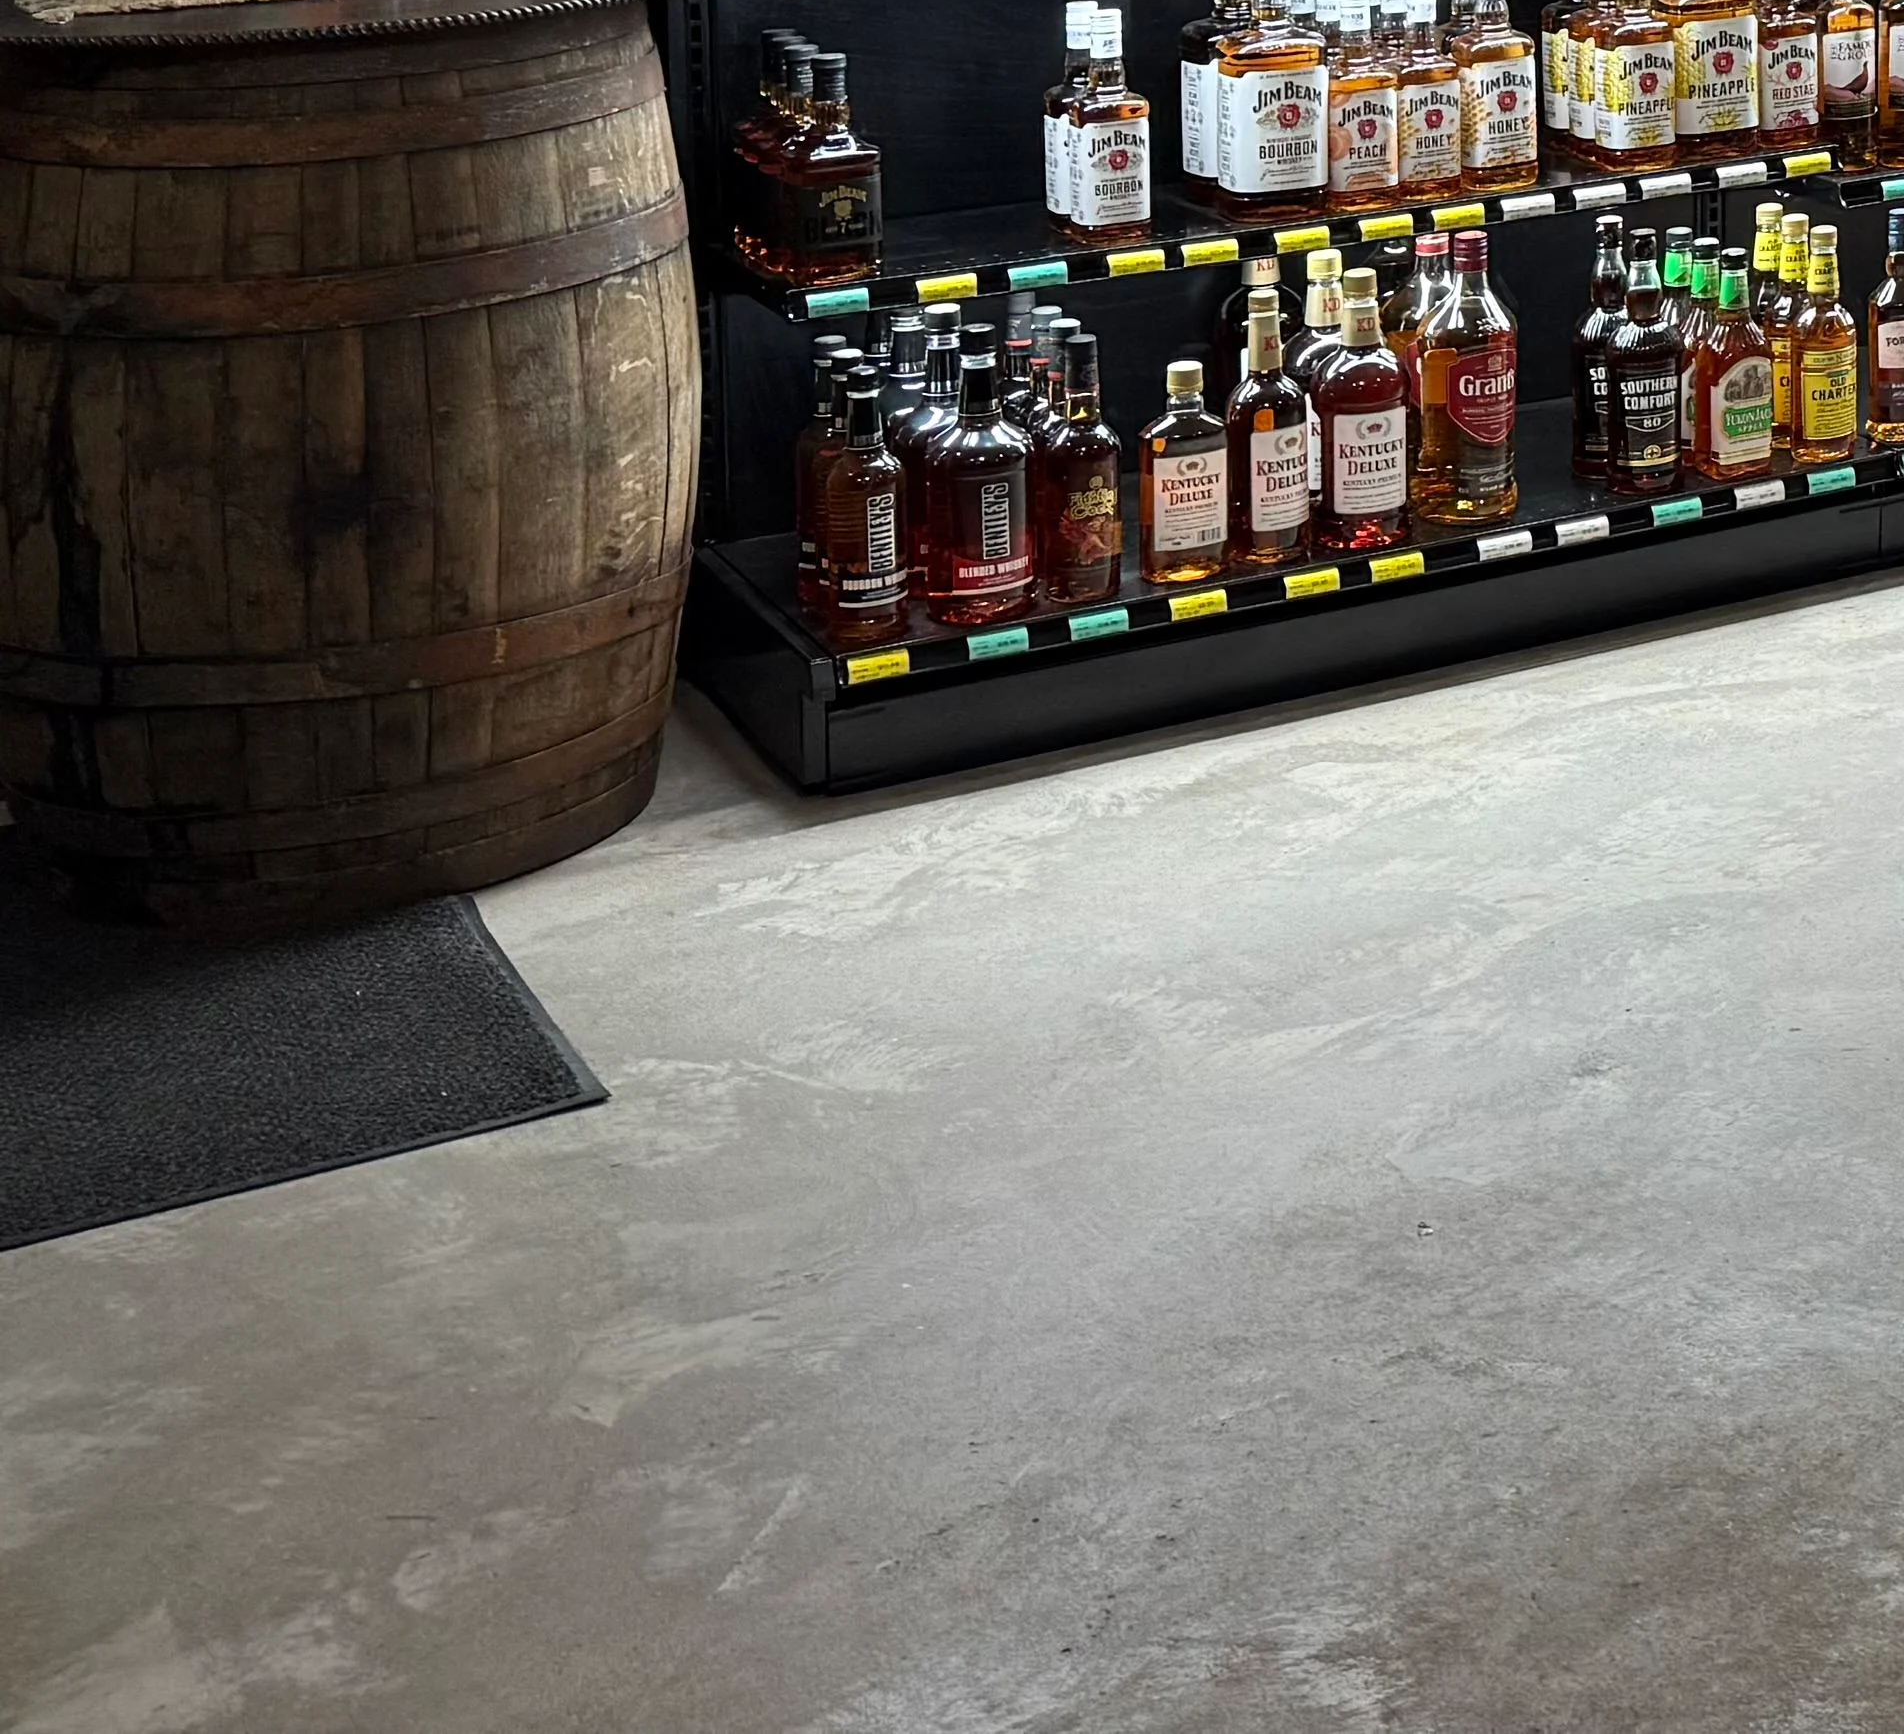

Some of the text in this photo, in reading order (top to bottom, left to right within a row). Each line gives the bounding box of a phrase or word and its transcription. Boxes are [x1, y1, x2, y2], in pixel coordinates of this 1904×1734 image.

[1691, 30, 1753, 61] JIM BEAM
[1768, 42, 1815, 68] JIM BEAM
[1620, 53, 1674, 81] JIM BEAM
[1476, 71, 1532, 100] JIM BEAM
[1688, 77, 1755, 99] PINEAPPLE
[1773, 86, 1793, 101] RED
[1253, 81, 1322, 113] JIM BEAM
[1405, 90, 1459, 117] JIM BEAM
[1338, 101, 1394, 126] JIM BEAM
[1489, 118, 1528, 134] HONEY
[1088, 130, 1145, 157] JIM BEAM
[1259, 140, 1318, 160] BOURBON
[1350, 143, 1387, 160] PEACH
[1416, 135, 1453, 150] HONEY
[1095, 180, 1144, 196] BOURBON
[1257, 258, 1275, 272] KD
[1323, 297, 1340, 313] KD
[1357, 318, 1375, 332] KD
[1459, 375, 1514, 396] Grant's
[1621, 376, 1678, 395] SOUTHERN
[1829, 375, 1847, 388] OLD
[1625, 391, 1675, 410] COMFORT
[1643, 417, 1661, 428] 80
[1339, 438, 1404, 459] KENTUCKY
[1347, 457, 1397, 476] DELUXE
[1161, 474, 1220, 493] KENTUCKY
[1170, 490, 1213, 506] DELUXE
[984, 483, 1009, 559] BENTLEY'S
[870, 494, 894, 571] BENTLEY'S
